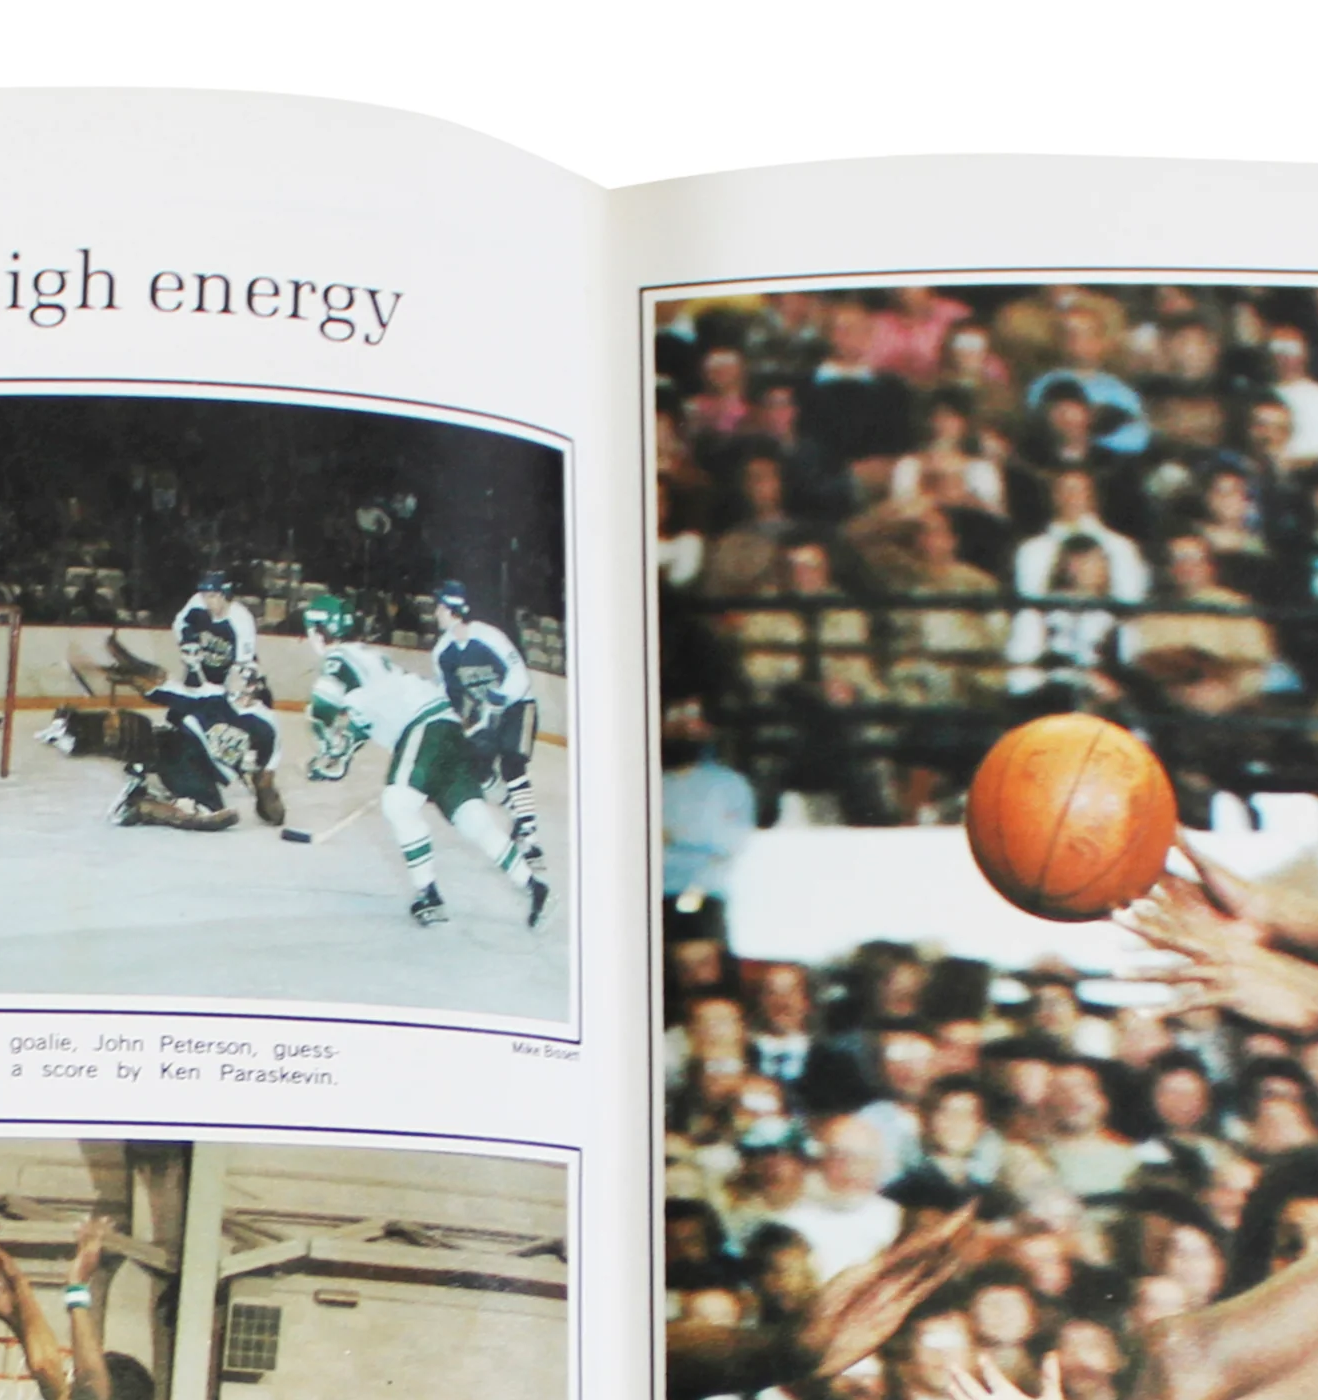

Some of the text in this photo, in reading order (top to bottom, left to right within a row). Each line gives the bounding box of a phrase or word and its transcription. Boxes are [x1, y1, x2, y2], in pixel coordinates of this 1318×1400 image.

[148, 270, 404, 347] energy
[8, 1033, 78, 1055] goalie,
[92, 1033, 144, 1052] John
[159, 1034, 258, 1058] Peterson,
[41, 1063, 99, 1079] score
[116, 1061, 143, 1082] by
[159, 1062, 201, 1081] Ken
[219, 1063, 338, 1086] Paraskevin.
